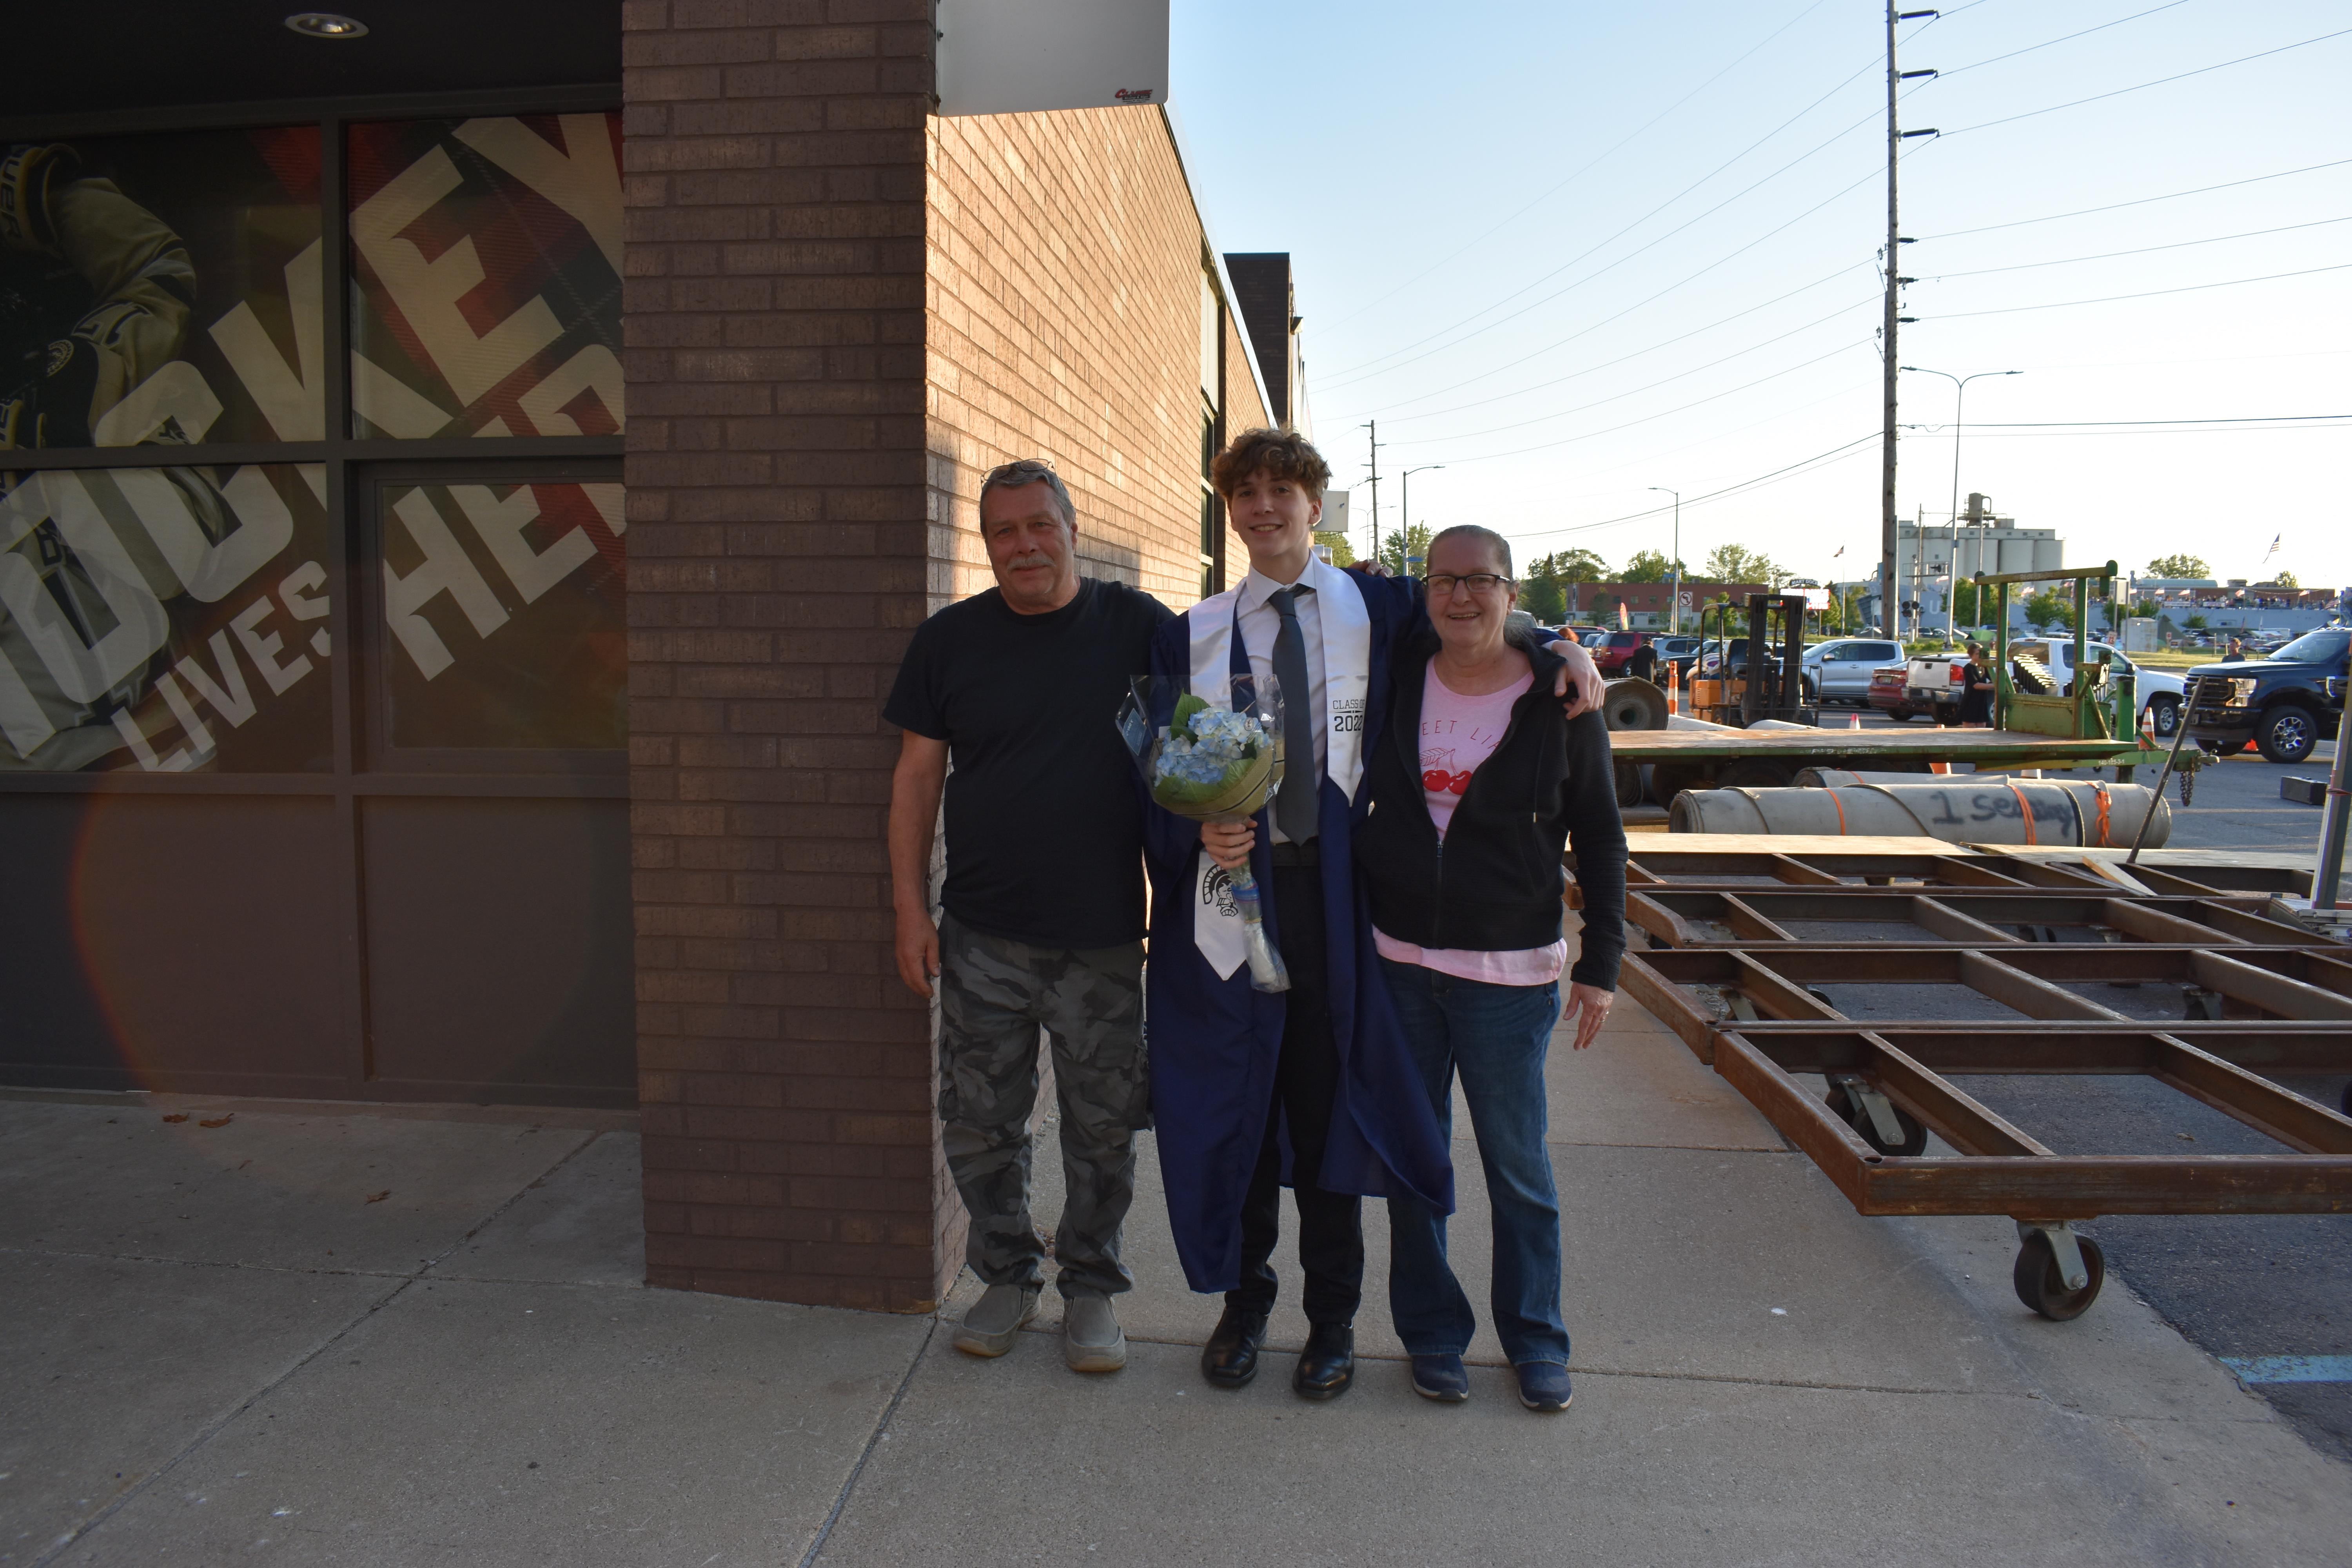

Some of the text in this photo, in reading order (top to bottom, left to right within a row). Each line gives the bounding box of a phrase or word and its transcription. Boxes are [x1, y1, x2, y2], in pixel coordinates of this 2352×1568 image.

[110, 561, 331, 772] LIVES
[1333, 699, 1358, 710] CLASS
[1334, 715, 1363, 732] 2022
